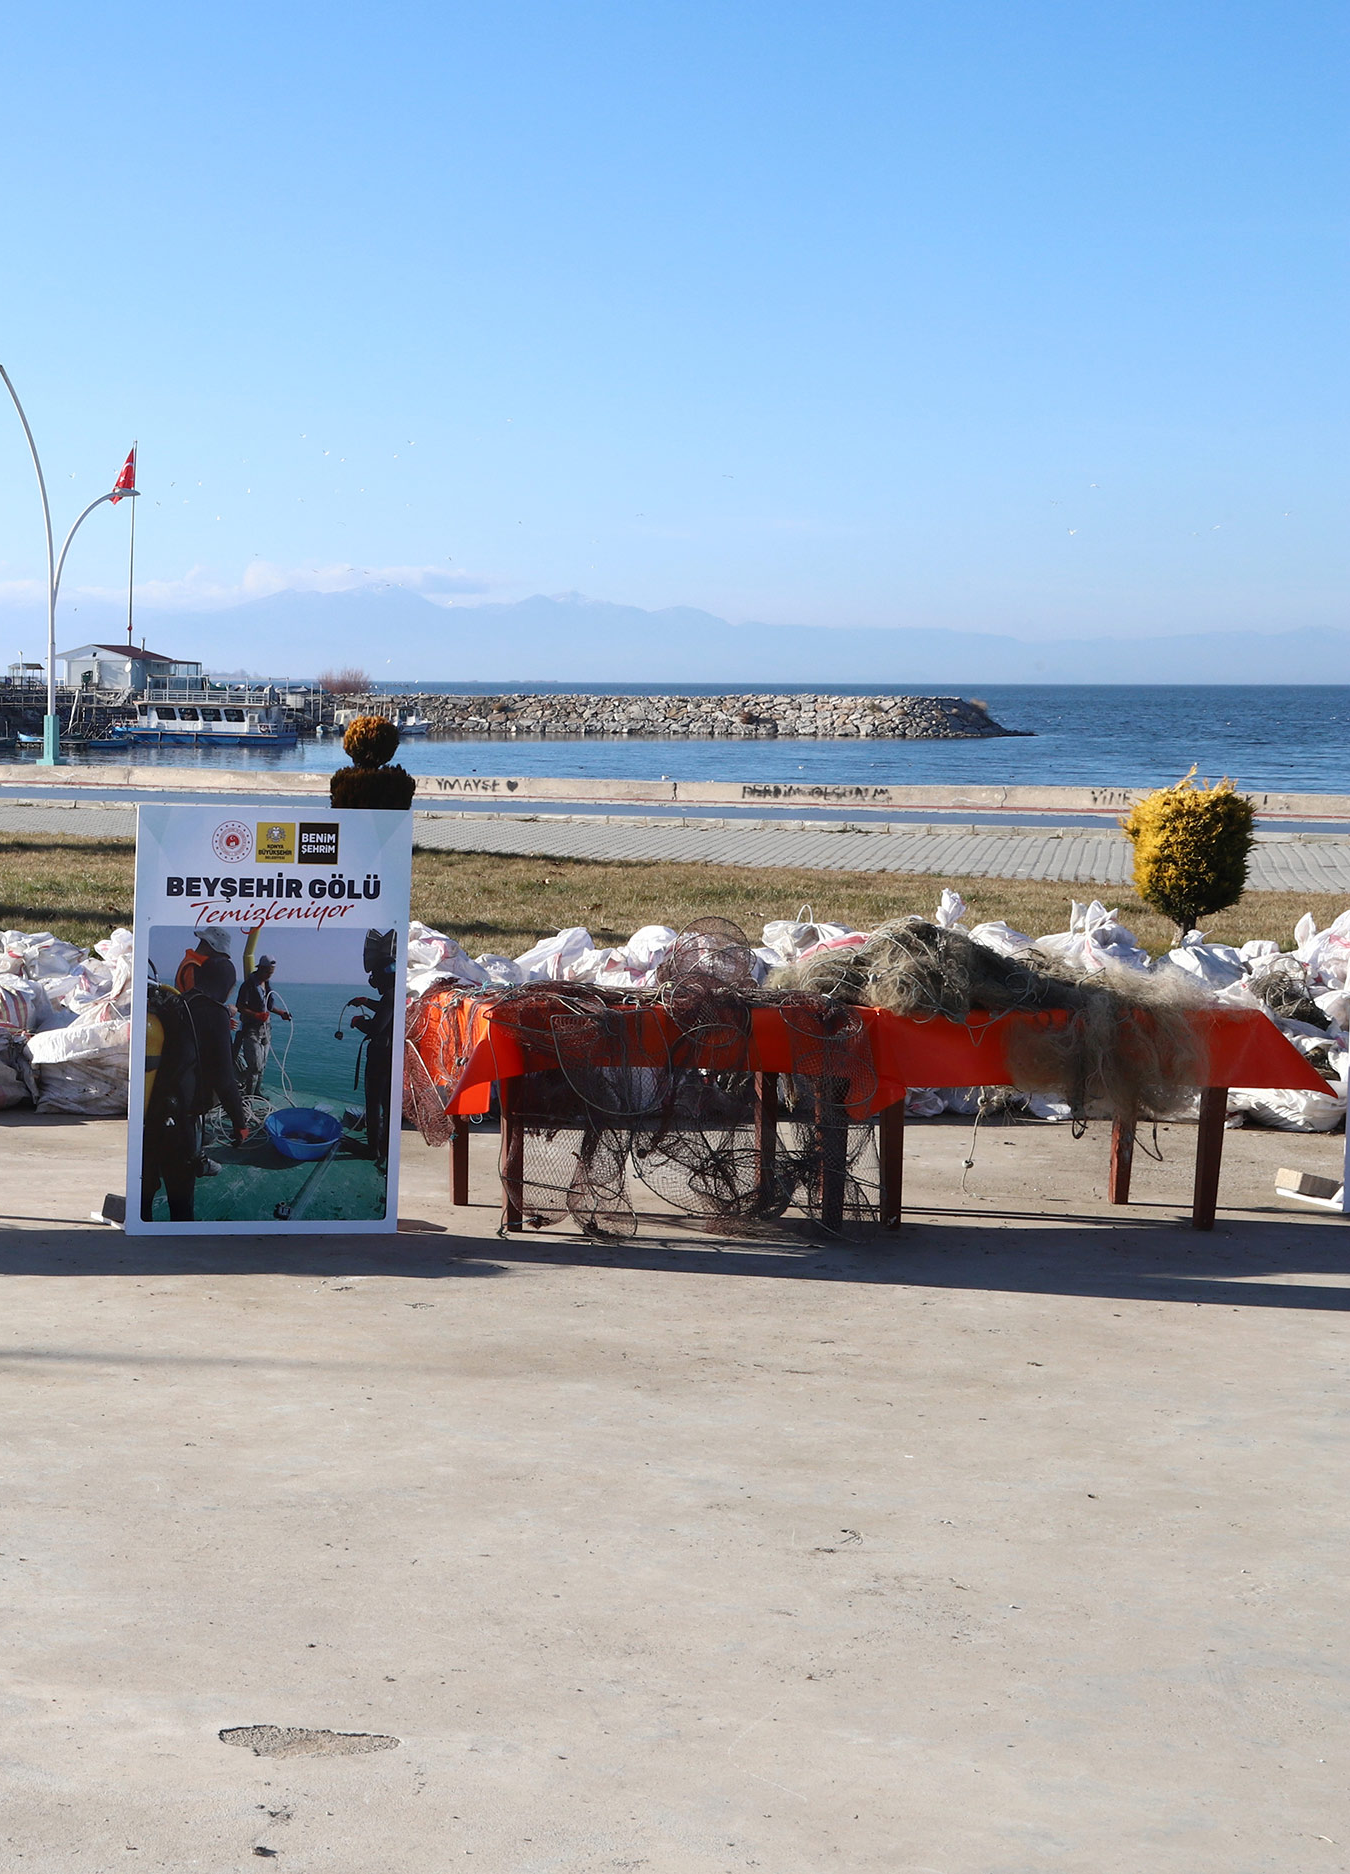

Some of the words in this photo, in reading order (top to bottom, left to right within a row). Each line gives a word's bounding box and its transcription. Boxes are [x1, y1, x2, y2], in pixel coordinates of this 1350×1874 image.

[301, 832, 336, 844] BENİM
[301, 843, 336, 855] ŞEHRİM
[166, 872, 303, 903] BEYŞEHİR
[308, 873, 381, 900] GÖLÜ
[190, 899, 354, 935] Temizleniyor
